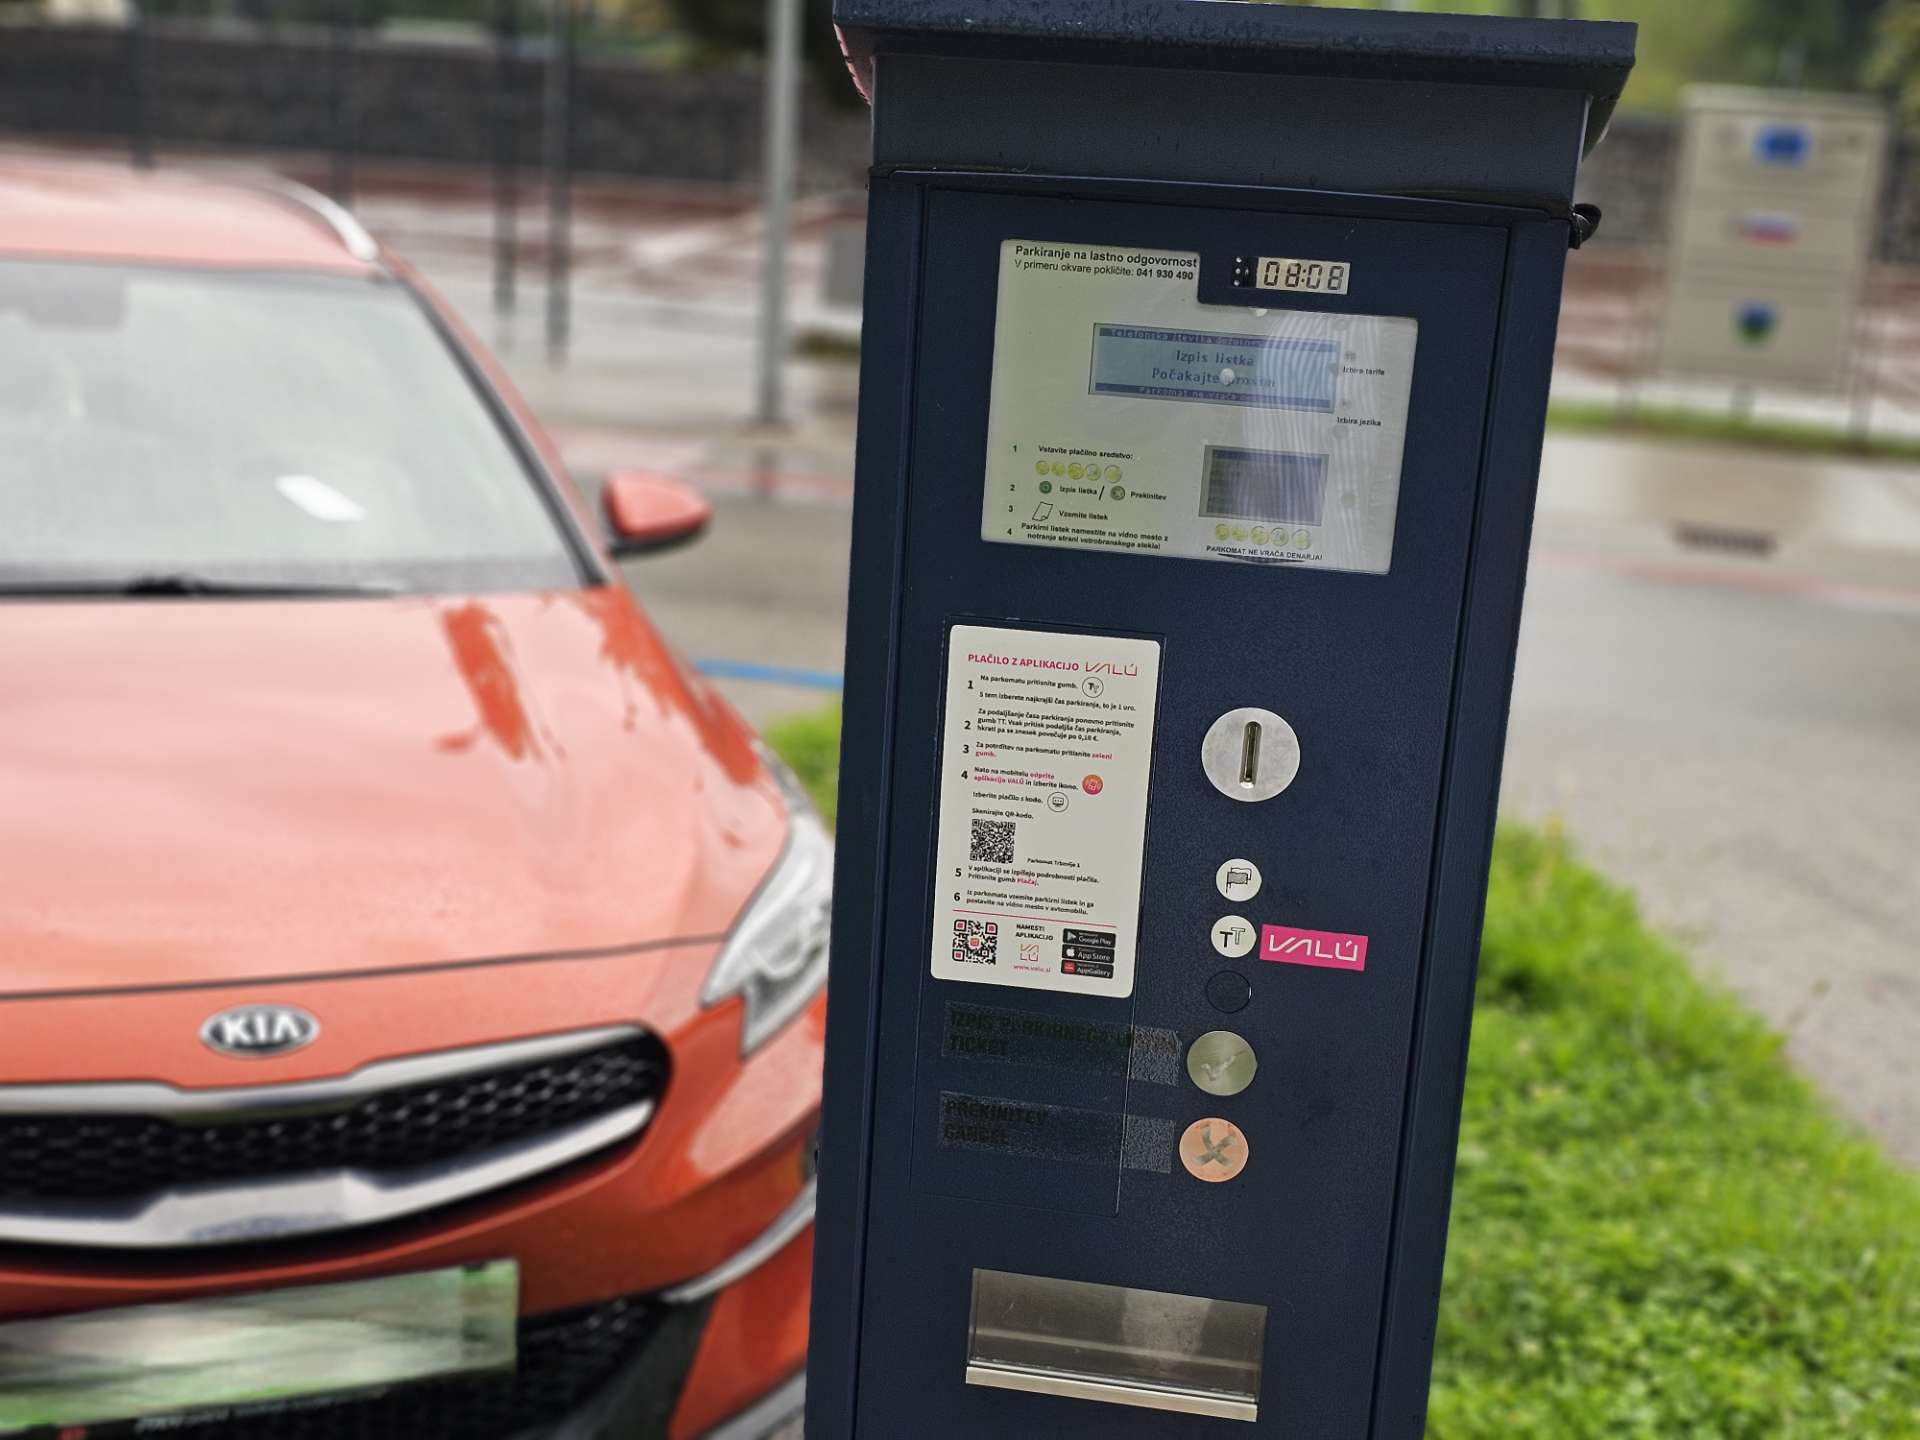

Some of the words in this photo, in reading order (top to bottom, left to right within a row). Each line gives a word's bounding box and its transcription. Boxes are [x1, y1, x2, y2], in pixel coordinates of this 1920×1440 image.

[1015, 245, 1071, 260] Parkiranje
[1074, 251, 1087, 260] na
[1090, 250, 1124, 262] lastno
[1127, 255, 1197, 268] odgovornost
[1014, 259, 1022, 268] V
[1023, 260, 1059, 271] primeru
[1061, 263, 1092, 273] okvare
[1094, 264, 1134, 276] pokličite:
[1136, 268, 1153, 278] 041
[1156, 269, 1174, 279] 930
[1175, 270, 1194, 281] 490
[1263, 261, 1345, 290] 08:08
[1176, 350, 1208, 364] Izpis
[1215, 352, 1255, 366] listka
[1152, 367, 1220, 385] Počakajte
[1337, 416, 1358, 425] Izbira
[1359, 418, 1382, 427] jezika
[1038, 445, 1067, 455] Vstavite
[1068, 447, 1098, 458] plačilno
[1099, 451, 1134, 461] sredstvo:
[1010, 484, 1015, 492] 2
[1078, 486, 1098, 495] listka
[1130, 491, 1168, 500] Prekinitev
[1008, 505, 1014, 513] 3
[1058, 510, 1087, 519] Vzemite
[1088, 512, 1108, 521] listek
[1007, 528, 1013, 536] 4
[1021, 522, 1050, 532] Parkirni
[1050, 524, 1070, 533] listek
[1071, 526, 1107, 538] namestite
[1117, 530, 1139, 540] vidno
[1140, 533, 1163, 542] mesto
[1027, 532, 1057, 543] notranje
[1058, 534, 1080, 543] strani
[1206, 545, 1246, 556] PARKOMAT
[1260, 549, 1285, 558] VRAČA
[1286, 551, 1324, 561] DENARJA!
[968, 653, 1010, 666] PLAČILO
[1011, 658, 1018, 666] Z
[1019, 658, 1080, 672] APLIKACIJO
[967, 680, 974, 690] 1
[990, 675, 1026, 685] parkomatu
[1026, 678, 1056, 687] pritisnite
[998, 692, 1024, 701] izberete
[1054, 697, 1065, 705] čas
[1110, 703, 1117, 711] je
[963, 721, 971, 730] 2
[977, 717, 996, 725] gumb
[1008, 719, 1023, 727] Vsak
[1023, 720, 1044, 729] pritisk
[1074, 724, 1085, 732] čas
[987, 708, 1024, 719] podaljšanje
[1025, 710, 1040, 719] časa
[1041, 712, 1074, 723] parkiranja
[1075, 717, 1104, 725] ponovno
[1105, 718, 1135, 728] pritisnite
[977, 725, 996, 733] hkrati
[1014, 728, 1037, 736] znesek
[1038, 730, 1067, 740] povečuje
[962, 744, 969, 754] 3
[975, 741, 984, 749] Za
[985, 743, 1014, 751] potrditev
[1024, 746, 1060, 756] parkomatu
[1061, 749, 1091, 758] pritisnite
[961, 770, 968, 780] 4
[974, 766, 990, 774] Nato
[999, 768, 1029, 778] mobitelu
[1029, 771, 1055, 780] odprite
[1025, 779, 1032, 787] in
[1032, 780, 1057, 788] izberite
[972, 791, 997, 800] Izberite
[955, 868, 962, 877] 5
[973, 865, 1002, 874] aplikaciji
[968, 873, 996, 881] Pritisnite
[998, 875, 1016, 884] gumb
[953, 892, 961, 902] 6
[973, 890, 1008, 899] parkomata
[1034, 895, 1060, 904] parkirni
[1078, 899, 1086, 907] in
[966, 897, 995, 906] postavite
[1050, 905, 1089, 915] avtomobilu.
[1016, 923, 1045, 932] NAMESTI
[1015, 932, 1054, 941] APLIKACIJO
[1078, 936, 1099, 945] Google
[1099, 937, 1113, 946] Play
[1078, 951, 1092, 960] App
[1092, 953, 1111, 961] Store
[1076, 966, 1111, 978] AppGallery
[222, 1014, 299, 1044] KIA
[950, 1034, 1009, 1056] TICKET
